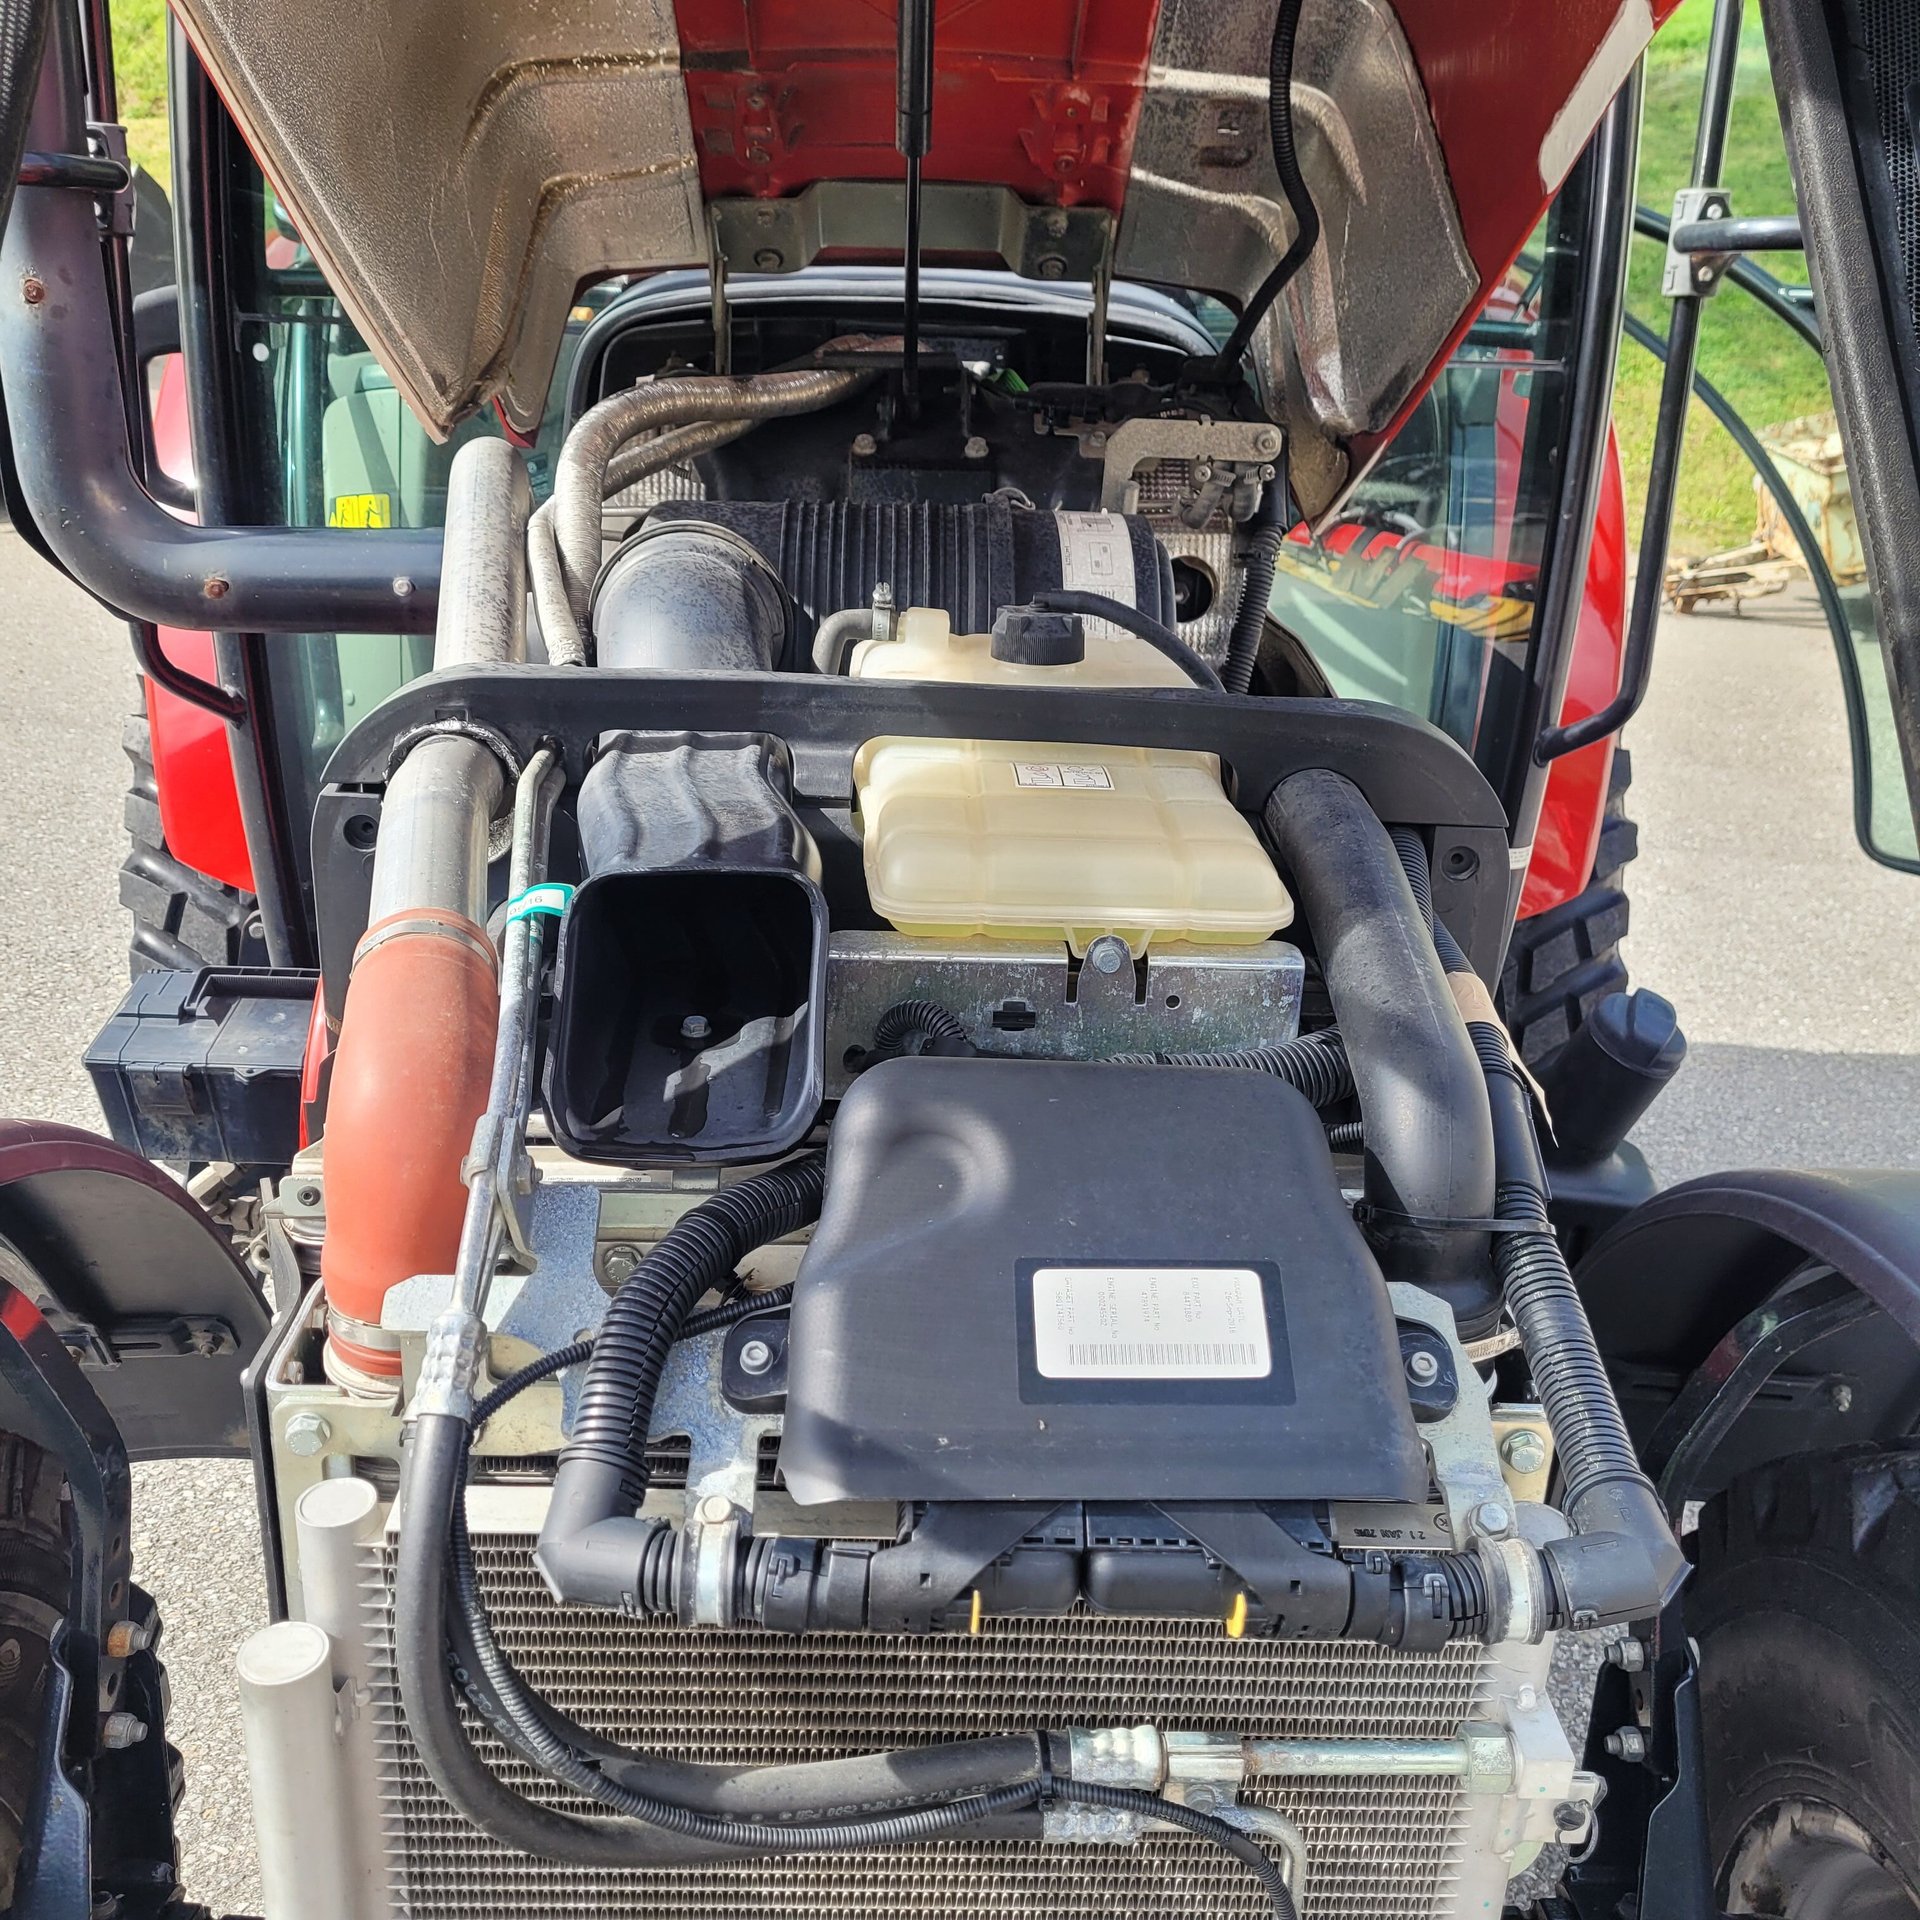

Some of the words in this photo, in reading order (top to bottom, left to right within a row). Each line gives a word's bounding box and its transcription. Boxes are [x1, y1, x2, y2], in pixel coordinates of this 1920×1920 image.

[1106, 1276, 1116, 1300] ENGINE
[1149, 1276, 1158, 1300] ENGINE
[1109, 1303, 1118, 1327] SERIAL
[1151, 1303, 1160, 1319] PART
[1380, 1529, 1403, 1540] JAN
